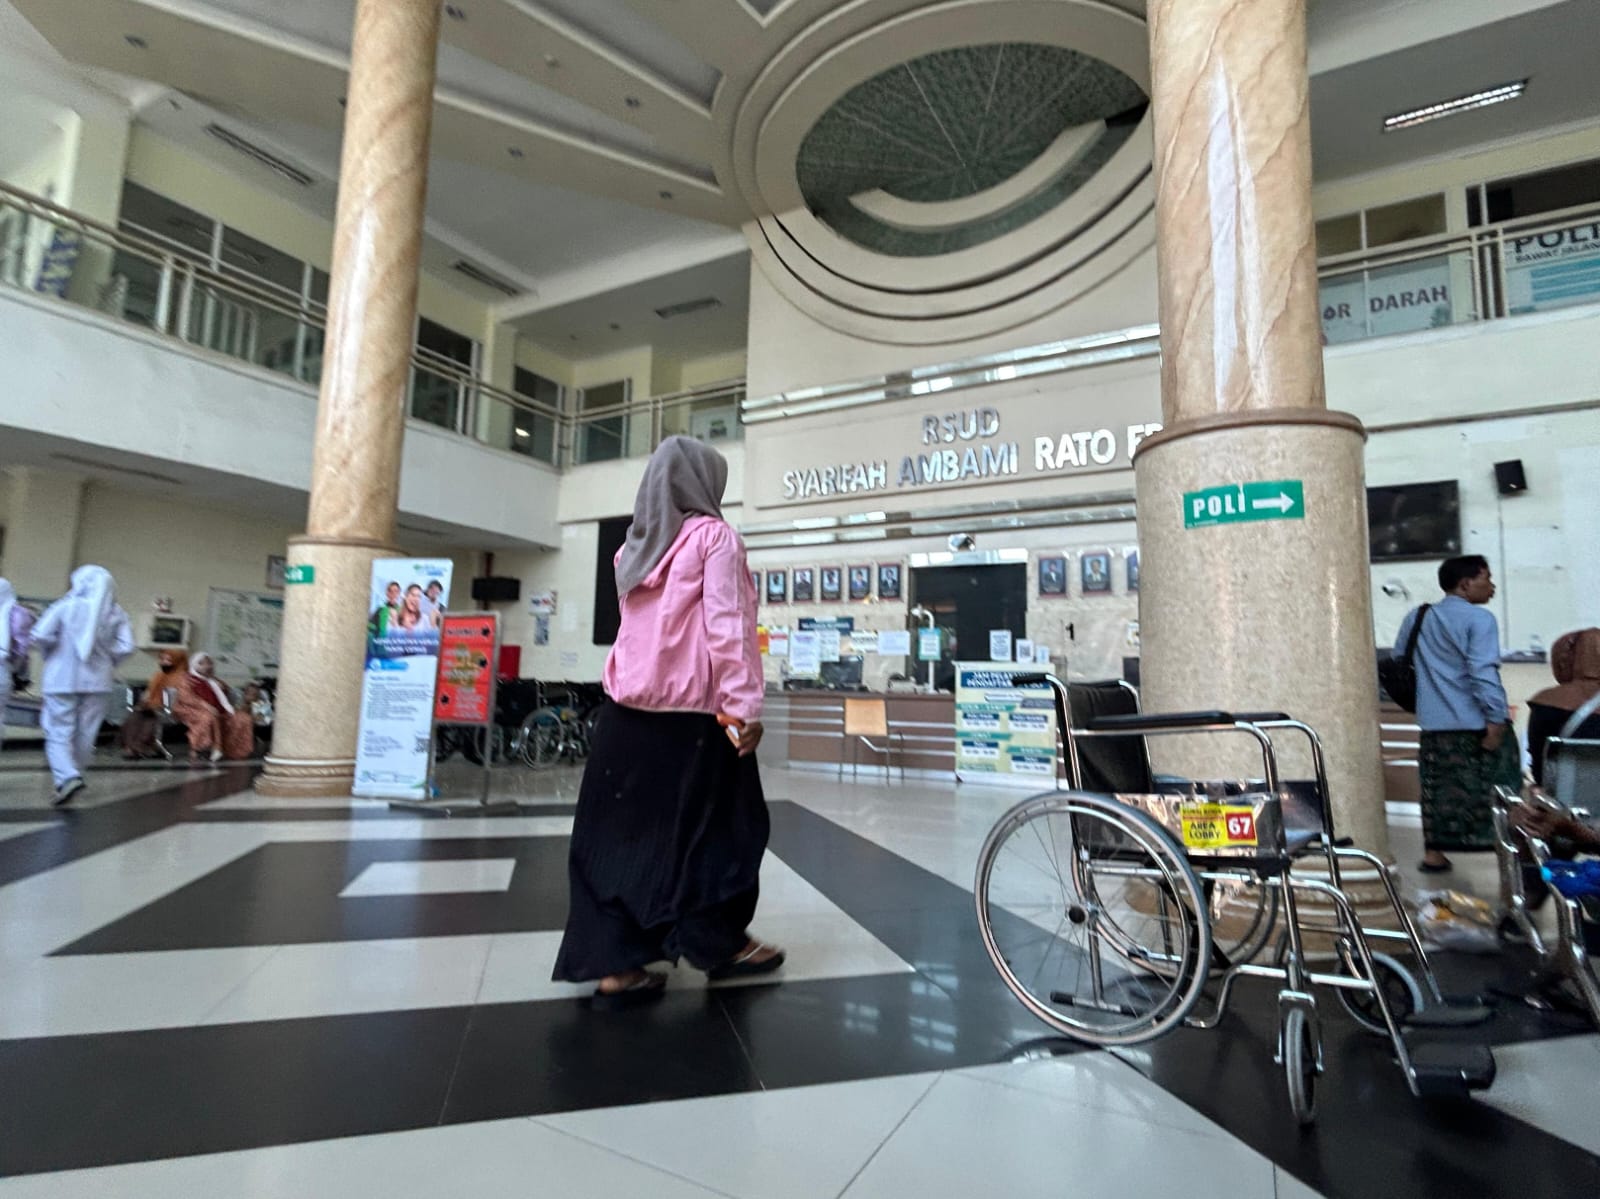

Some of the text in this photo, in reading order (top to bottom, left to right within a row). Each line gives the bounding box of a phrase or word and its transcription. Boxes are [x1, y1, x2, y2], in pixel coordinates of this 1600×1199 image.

[1515, 224, 1599, 253] POLI
[1369, 285, 1449, 313] DARAH
[922, 407, 1000, 445] RSUD
[783, 459, 888, 500] SYARIFAH
[896, 442, 1019, 487] AMBAMI
[1034, 429, 1117, 471] RATO
[1192, 493, 1246, 519] POLI
[1189, 831, 1221, 840] LOBBY
[1190, 822, 1216, 830] AREA
[1228, 816, 1251, 836] 67
